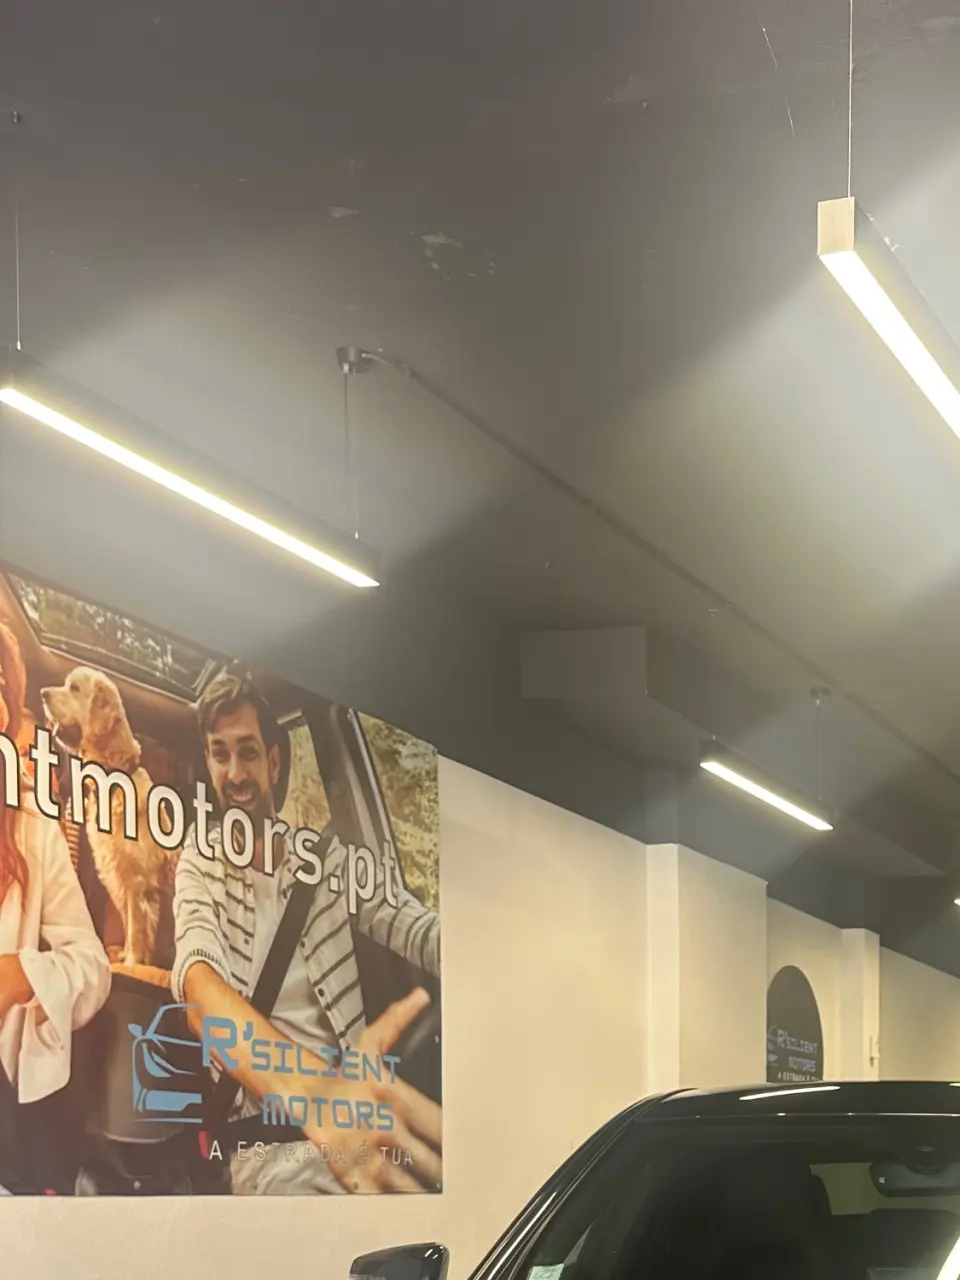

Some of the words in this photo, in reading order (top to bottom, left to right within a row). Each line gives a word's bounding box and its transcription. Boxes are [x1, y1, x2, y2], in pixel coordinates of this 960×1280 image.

[202, 1014, 401, 1085] R'SILIENT
[262, 1093, 395, 1132] MOTORS
[209, 1140, 223, 1161] A
[380, 1146, 413, 1165] TUA
